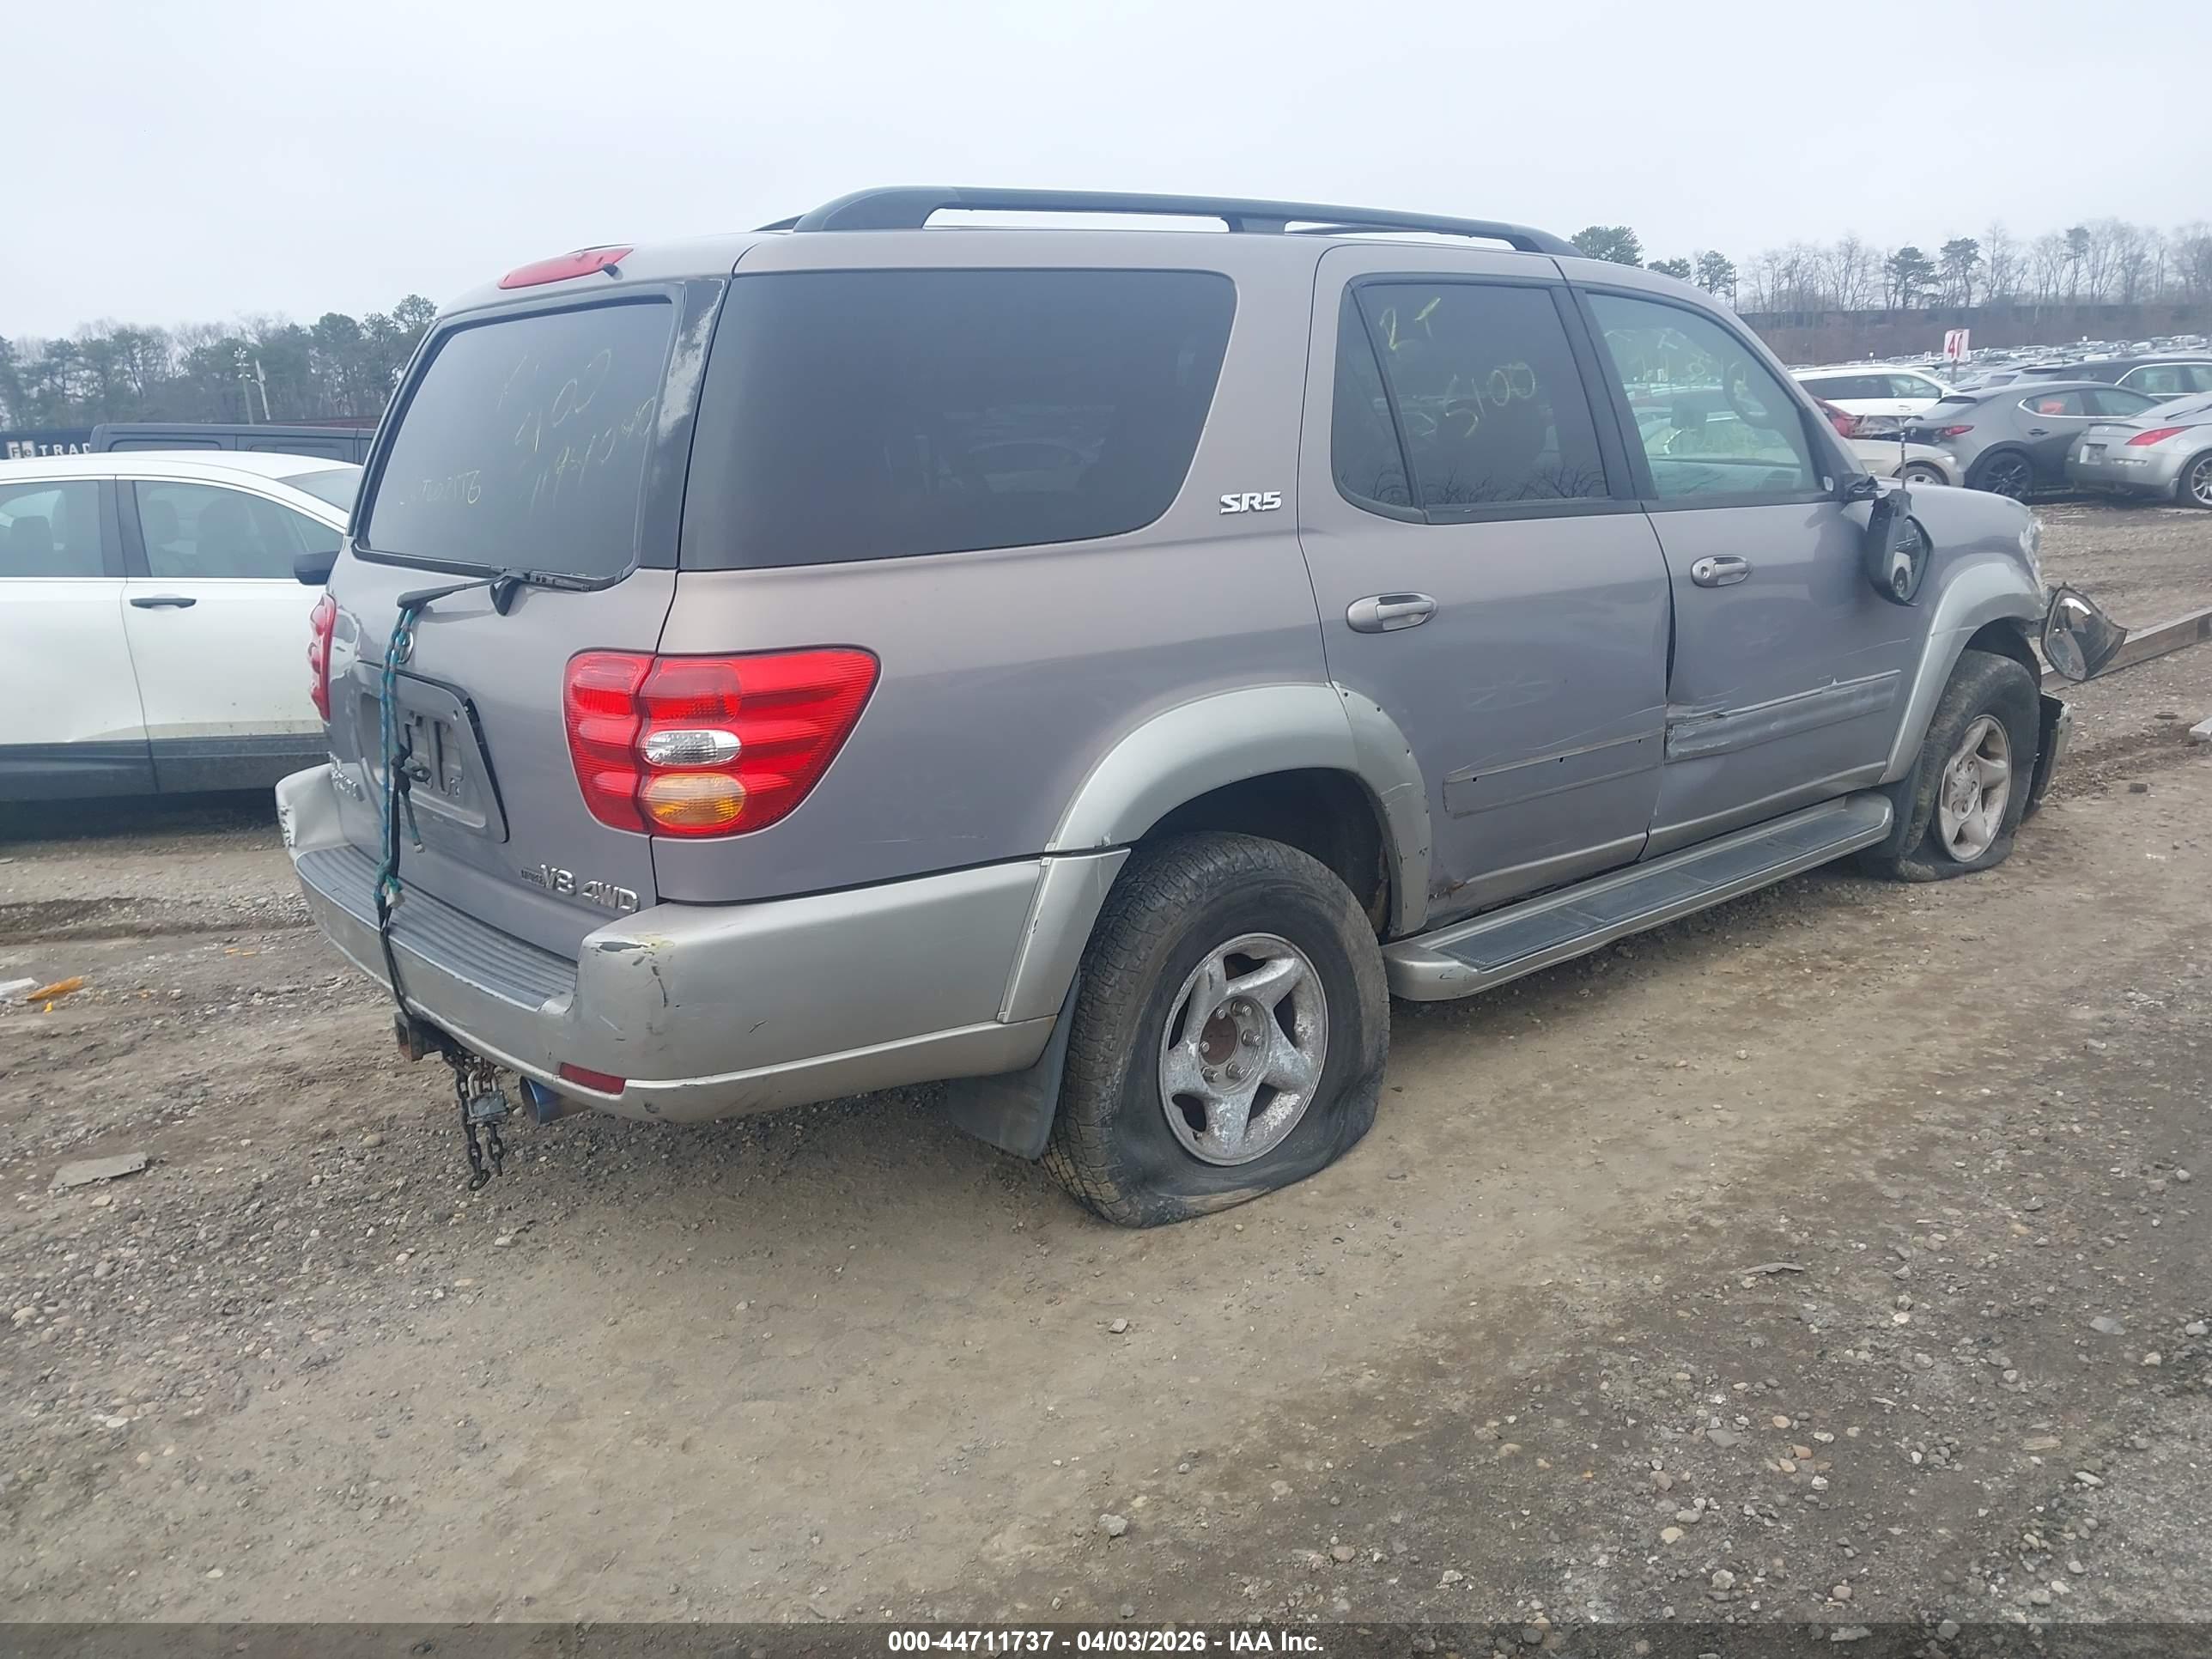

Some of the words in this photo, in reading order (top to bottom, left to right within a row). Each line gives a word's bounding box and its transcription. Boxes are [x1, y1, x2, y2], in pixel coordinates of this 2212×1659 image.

[1220, 490, 1283, 514] SR5
[539, 863, 577, 896] V8
[581, 879, 641, 914] 4WD
